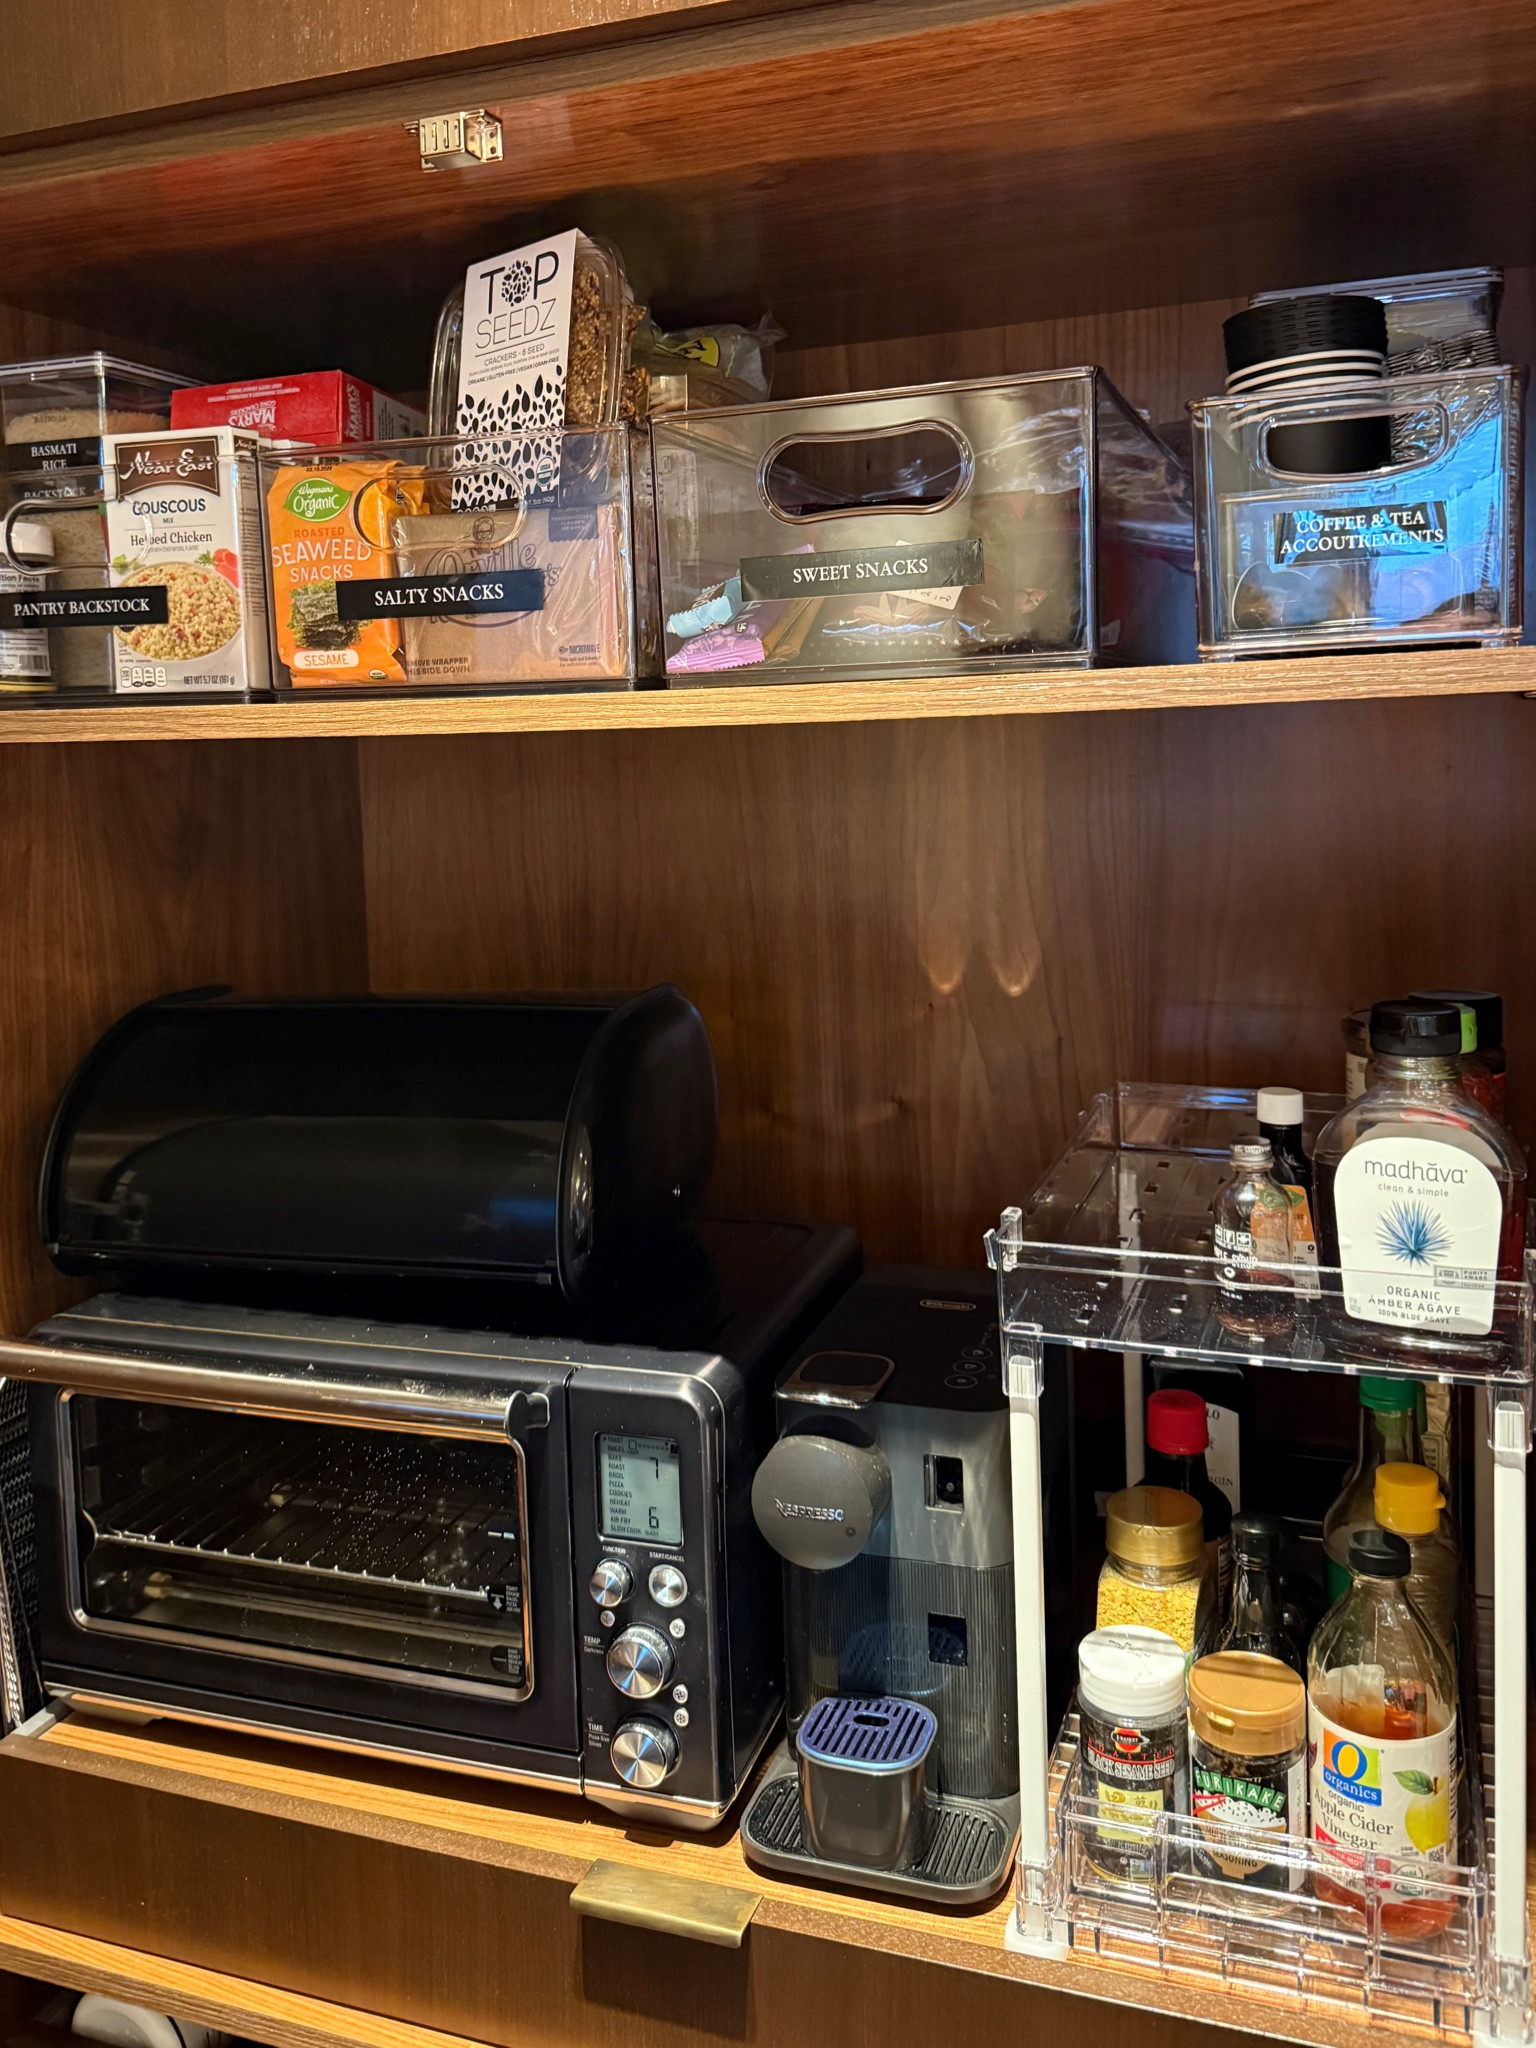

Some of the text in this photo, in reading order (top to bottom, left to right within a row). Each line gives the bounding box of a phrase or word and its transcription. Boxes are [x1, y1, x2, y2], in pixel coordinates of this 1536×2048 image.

[479, 250, 560, 315] TOP
[476, 297, 557, 349] SEEDZ
[484, 350, 518, 367] CRACKERS
[527, 343, 545, 355] SEED
[30, 443, 78, 458] BASMATI
[42, 459, 68, 471] RICE
[119, 448, 215, 480] Near East
[298, 482, 334, 498] Wegmans
[132, 498, 207, 516] COUSCOUS
[293, 493, 340, 518] Organic
[1296, 510, 1426, 534] COFFEE & TEA
[169, 530, 213, 546] Chicken
[294, 526, 345, 539] ROASTED
[1280, 528, 1444, 554] ACCOUTREMENTS
[271, 538, 372, 568] SEAWEED
[290, 563, 353, 583] SNACKS
[792, 557, 929, 584] SWEET SNACKS
[374, 583, 504, 607] SALTY SNACKS
[13, 598, 151, 617] PANTRY BACKSTOCK
[304, 653, 349, 667] SESAME
[406, 656, 469, 668] EMOVE WRAPPER
[406, 666, 422, 675] HIS
[442, 664, 471, 675] DOWN
[1378, 1183, 1450, 1198] clean & simple
[1387, 1285, 1441, 1302] ORGANIC
[1378, 1308, 1450, 1325] 100% BLUE AGAVE
[1417, 1302, 1462, 1316] AGAVE
[608, 1462, 625, 1471] ROAST
[608, 1471, 625, 1480] BROIL
[608, 1480, 625, 1488] PIZZA
[608, 1488, 633, 1498] COOKIES
[609, 1498, 631, 1507] REHEAT
[609, 1506, 627, 1515] WARM
[648, 1506, 660, 1529] 6
[610, 1524, 642, 1535] SLOW COOK
[602, 1544, 627, 1555] FUNCTION
[649, 1551, 685, 1563] START/CANCEL
[583, 1635, 601, 1644] TEMP
[583, 1645, 605, 1655] Darkness
[587, 1722, 604, 1732] TIME
[1114, 1763, 1154, 1781] SESAME
[1194, 1768, 1285, 1811] FURIKAKE
[1325, 1770, 1378, 1801] organics
[1328, 1789, 1365, 1813] organic
[1314, 1787, 1395, 1836] Apple Cider
[1321, 1812, 1378, 1851] Vinegar
[1212, 1849, 1259, 1868] SEASONING
